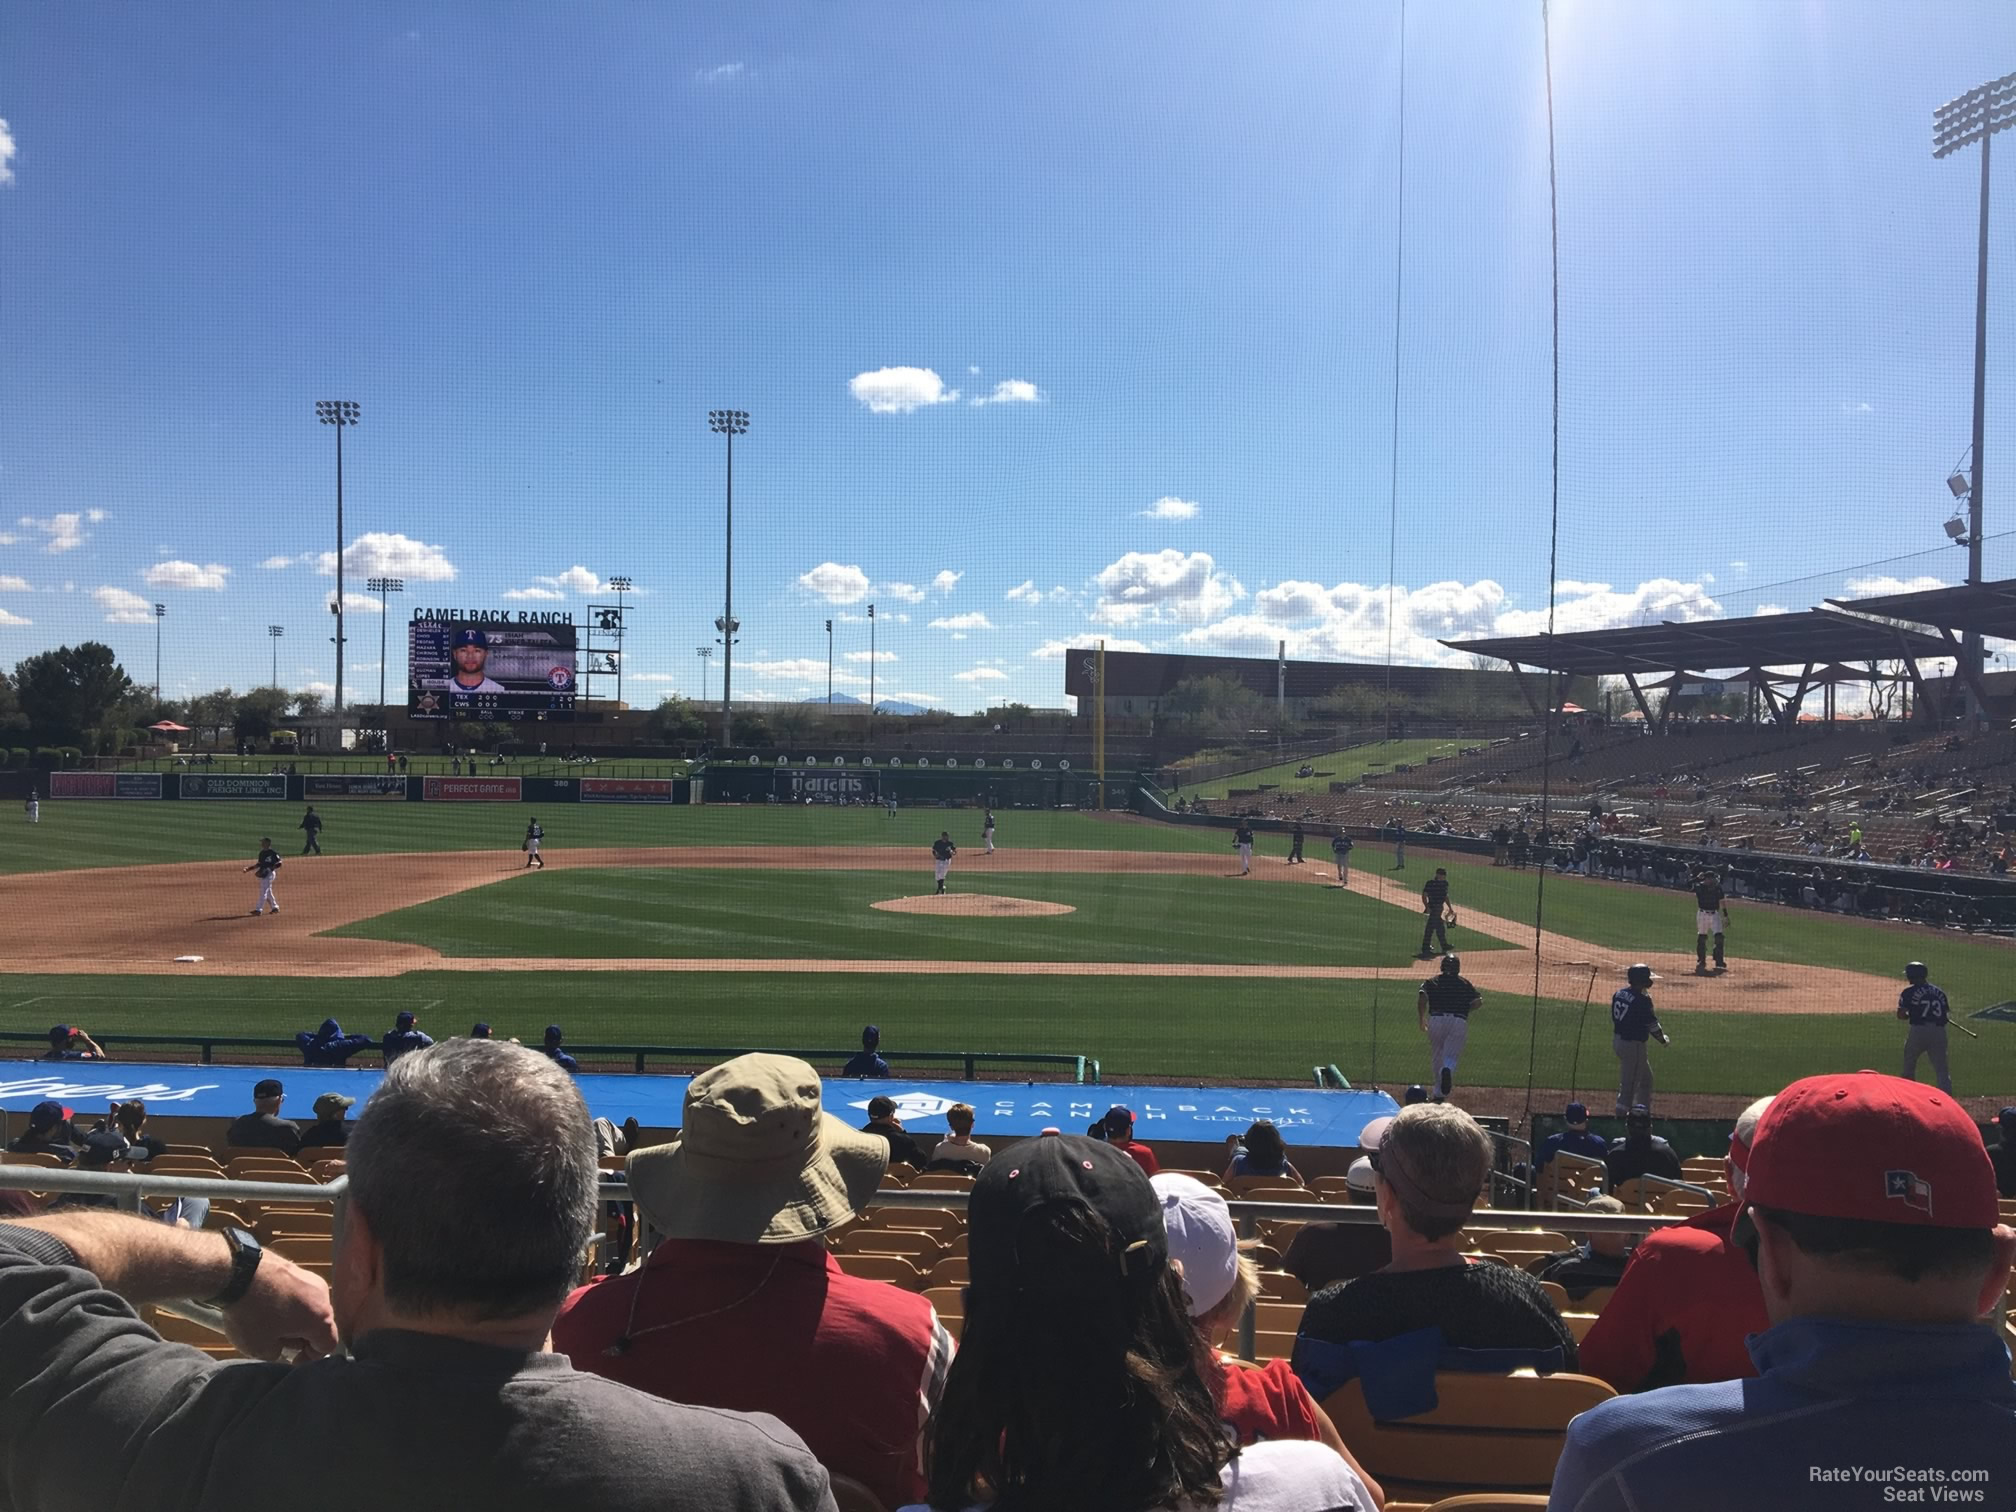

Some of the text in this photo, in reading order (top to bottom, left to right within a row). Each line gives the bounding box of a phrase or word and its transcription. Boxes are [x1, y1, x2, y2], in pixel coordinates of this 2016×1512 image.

[414, 608, 572, 625] CAMELBACK RANCH
[489, 635, 503, 643] 73
[444, 784, 478, 793] PERFECT
[1613, 1001, 1629, 1022] 67
[1920, 1000, 1942, 1017] 73
[993, 1109, 1167, 1120] RANH
